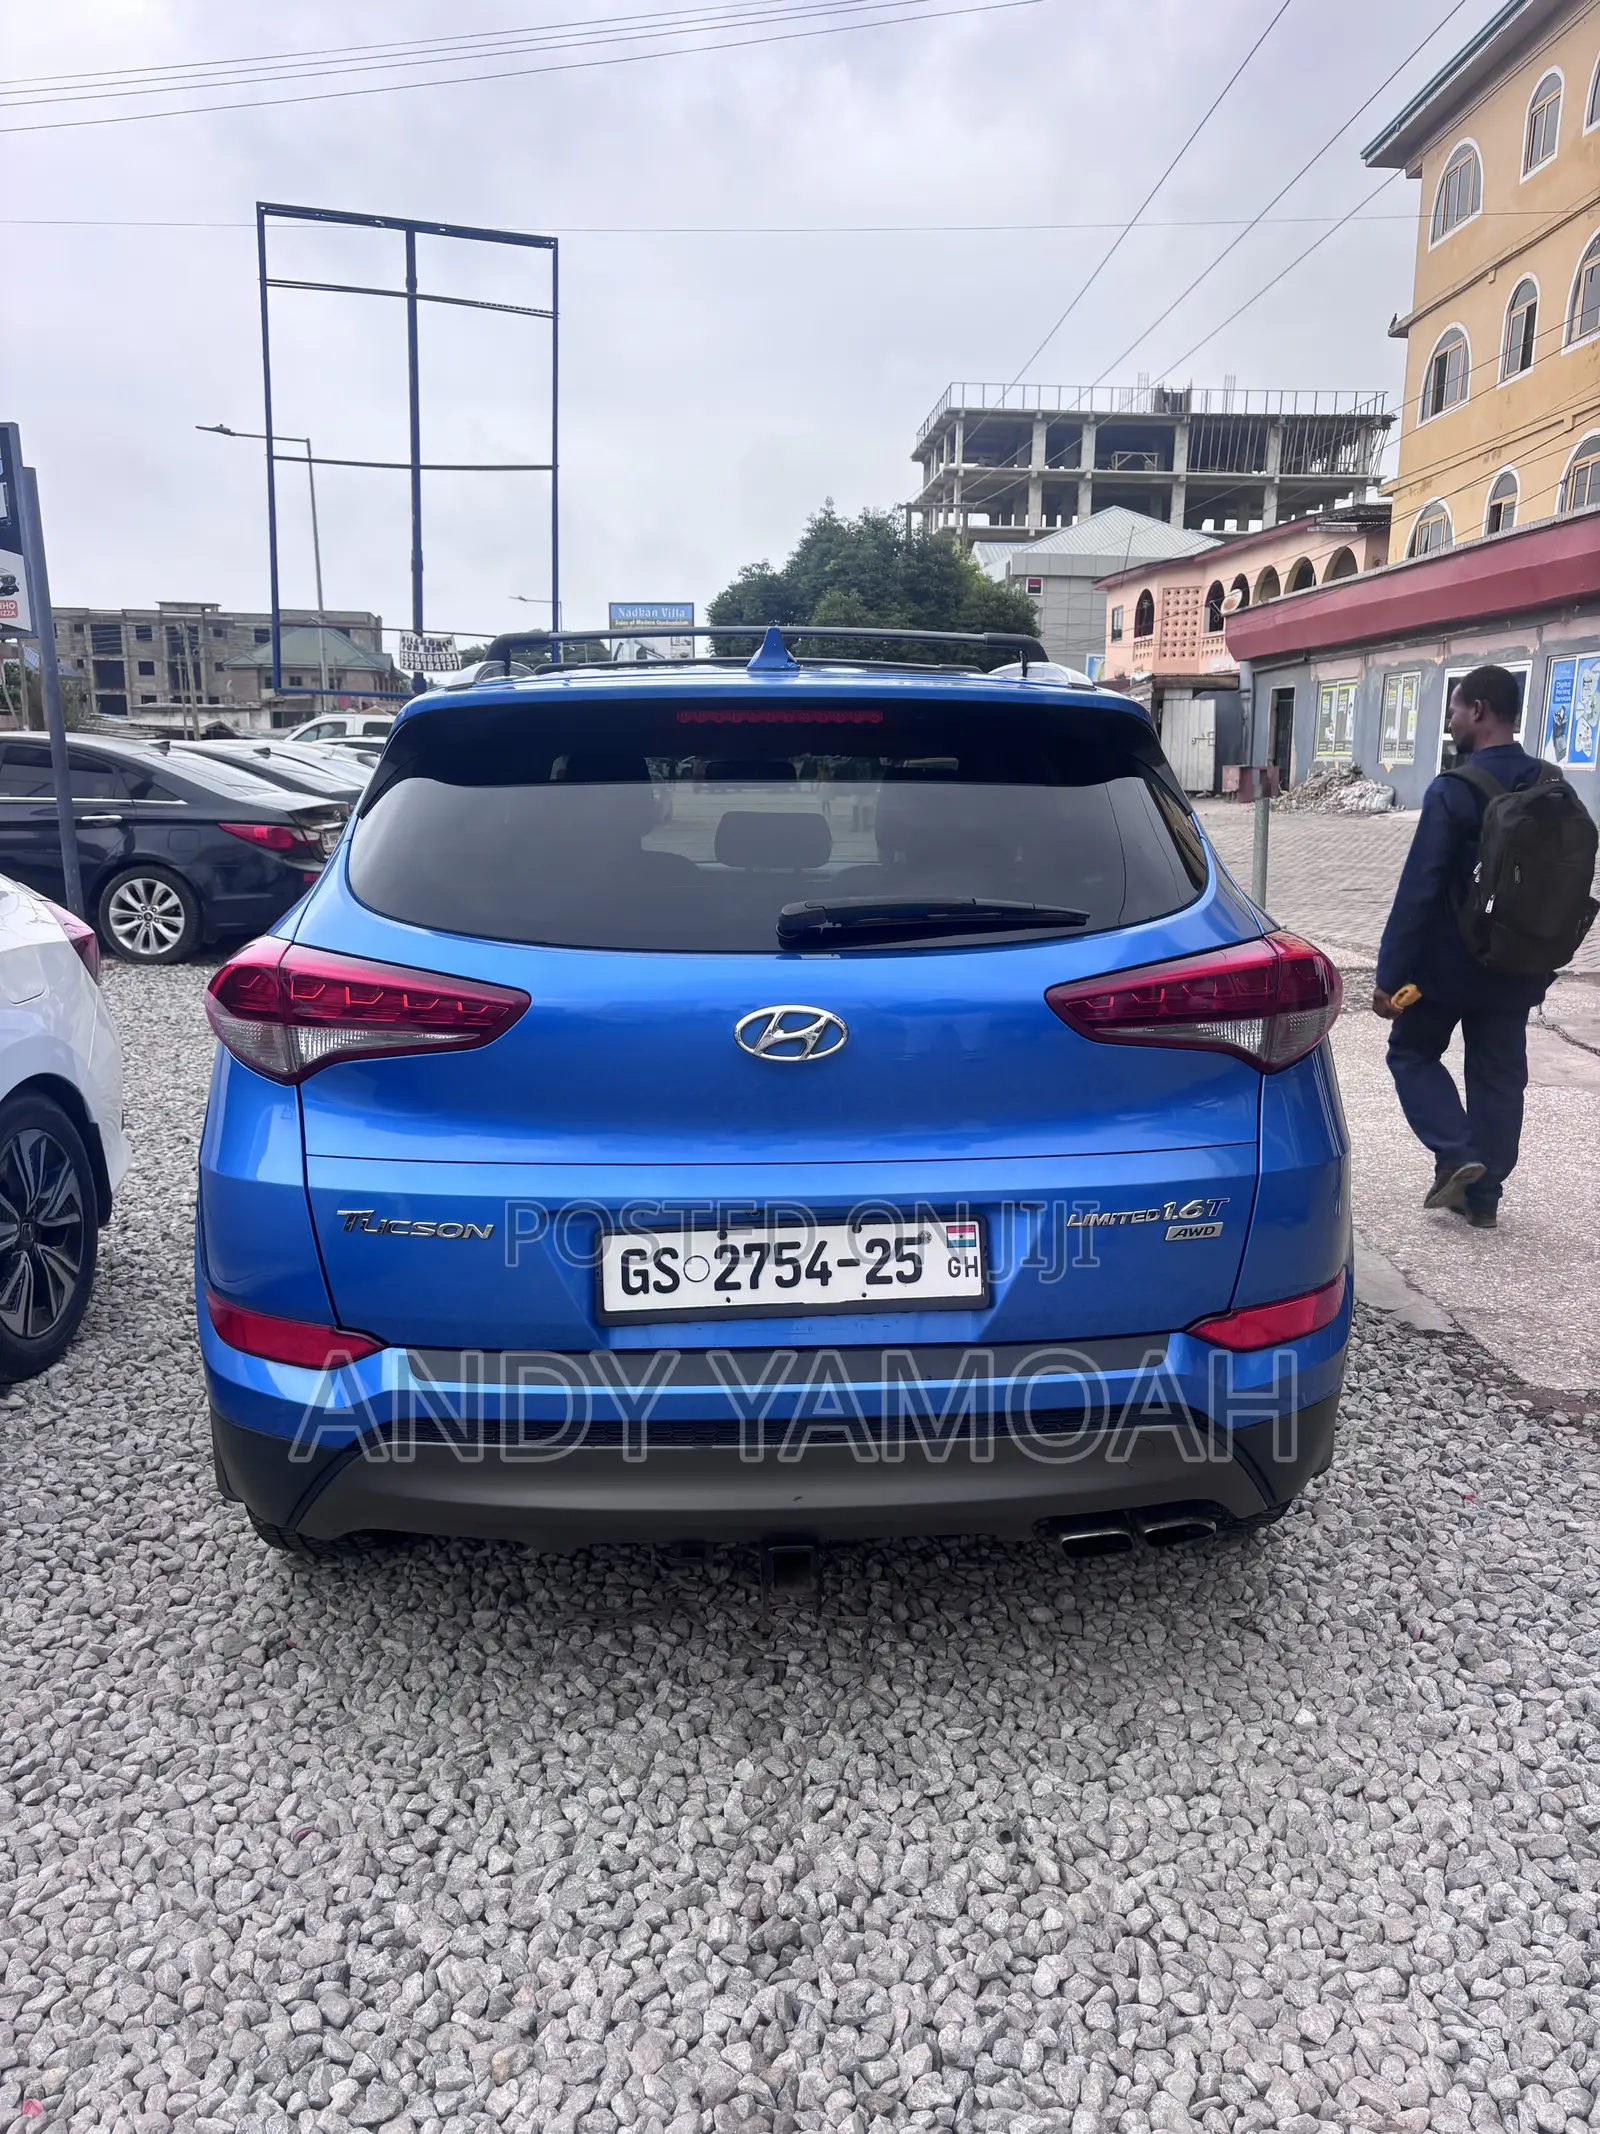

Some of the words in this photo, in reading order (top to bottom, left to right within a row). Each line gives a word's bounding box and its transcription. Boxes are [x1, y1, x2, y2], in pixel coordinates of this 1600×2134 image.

[661, 607, 685, 618] Villa
[402, 643, 420, 652] FOR
[1556, 681, 1571, 690] Digital
[337, 1210, 494, 1239] TUCSON
[1066, 1209, 1161, 1227] LIMITED
[1172, 1225, 1216, 1239] AWD
[620, 1246, 681, 1296] GS
[713, 1237, 922, 1292] 2754-25
[947, 1255, 979, 1279] GH
